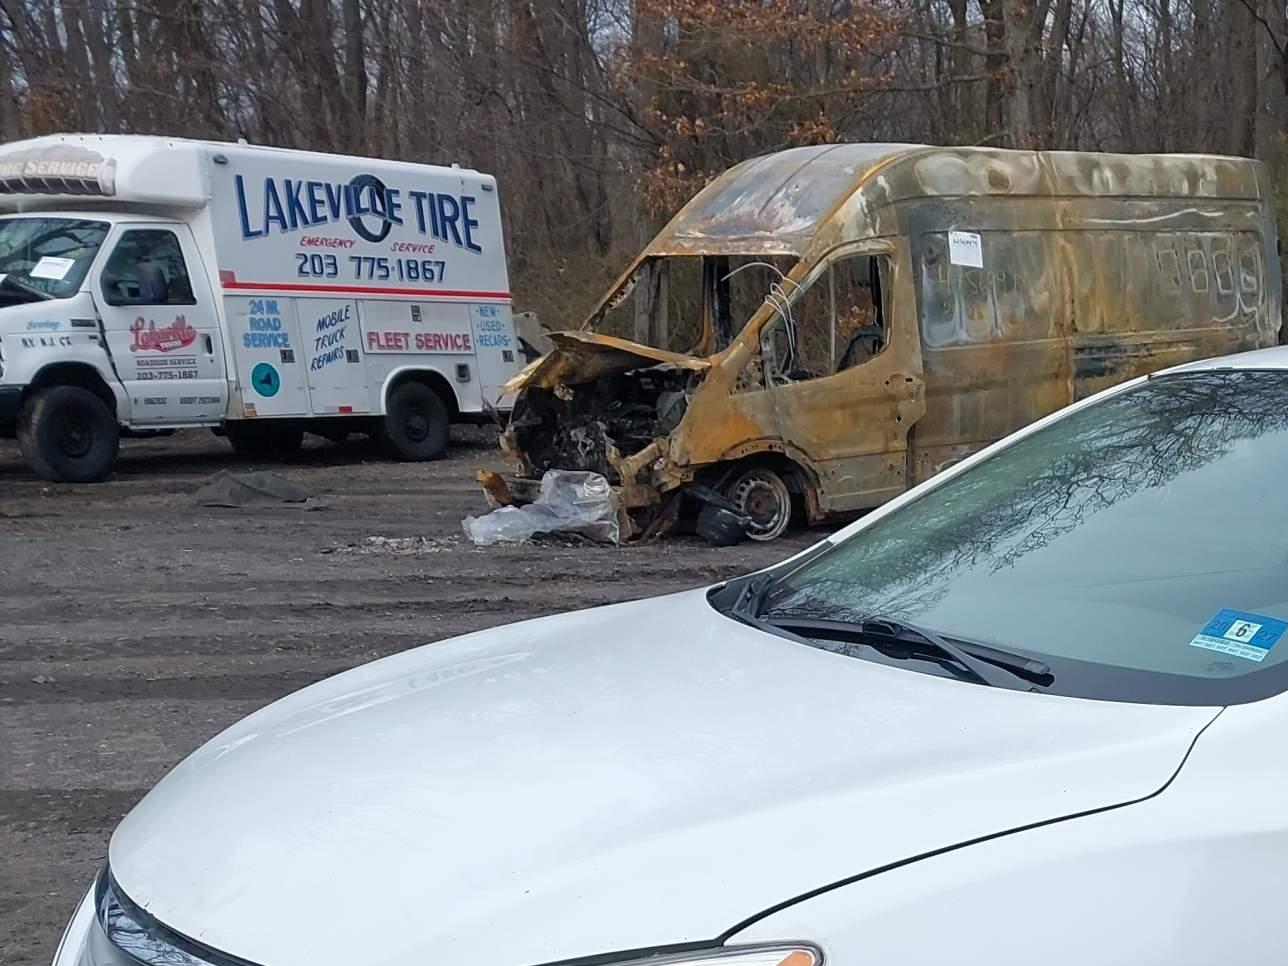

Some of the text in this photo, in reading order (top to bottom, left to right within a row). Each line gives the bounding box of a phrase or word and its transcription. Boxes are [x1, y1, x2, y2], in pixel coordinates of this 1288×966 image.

[24, 160, 98, 177] SERVICE
[235, 174, 482, 254] LAKEVILLE TIRE
[299, 235, 435, 254] EMERGENCY SERVICE
[295, 253, 339, 278] 203
[248, 299, 264, 315] 24
[249, 317, 281, 332] ROAD
[316, 304, 351, 333] MOBILE
[242, 332, 290, 348] SERVICE
[314, 326, 347, 352] TRUCK
[367, 331, 472, 351] FLEET SERVICE
[310, 345, 346, 372] REPAIRS
[136, 370, 199, 381] 203-775-1867
[1235, 623, 1250, 638] 6
